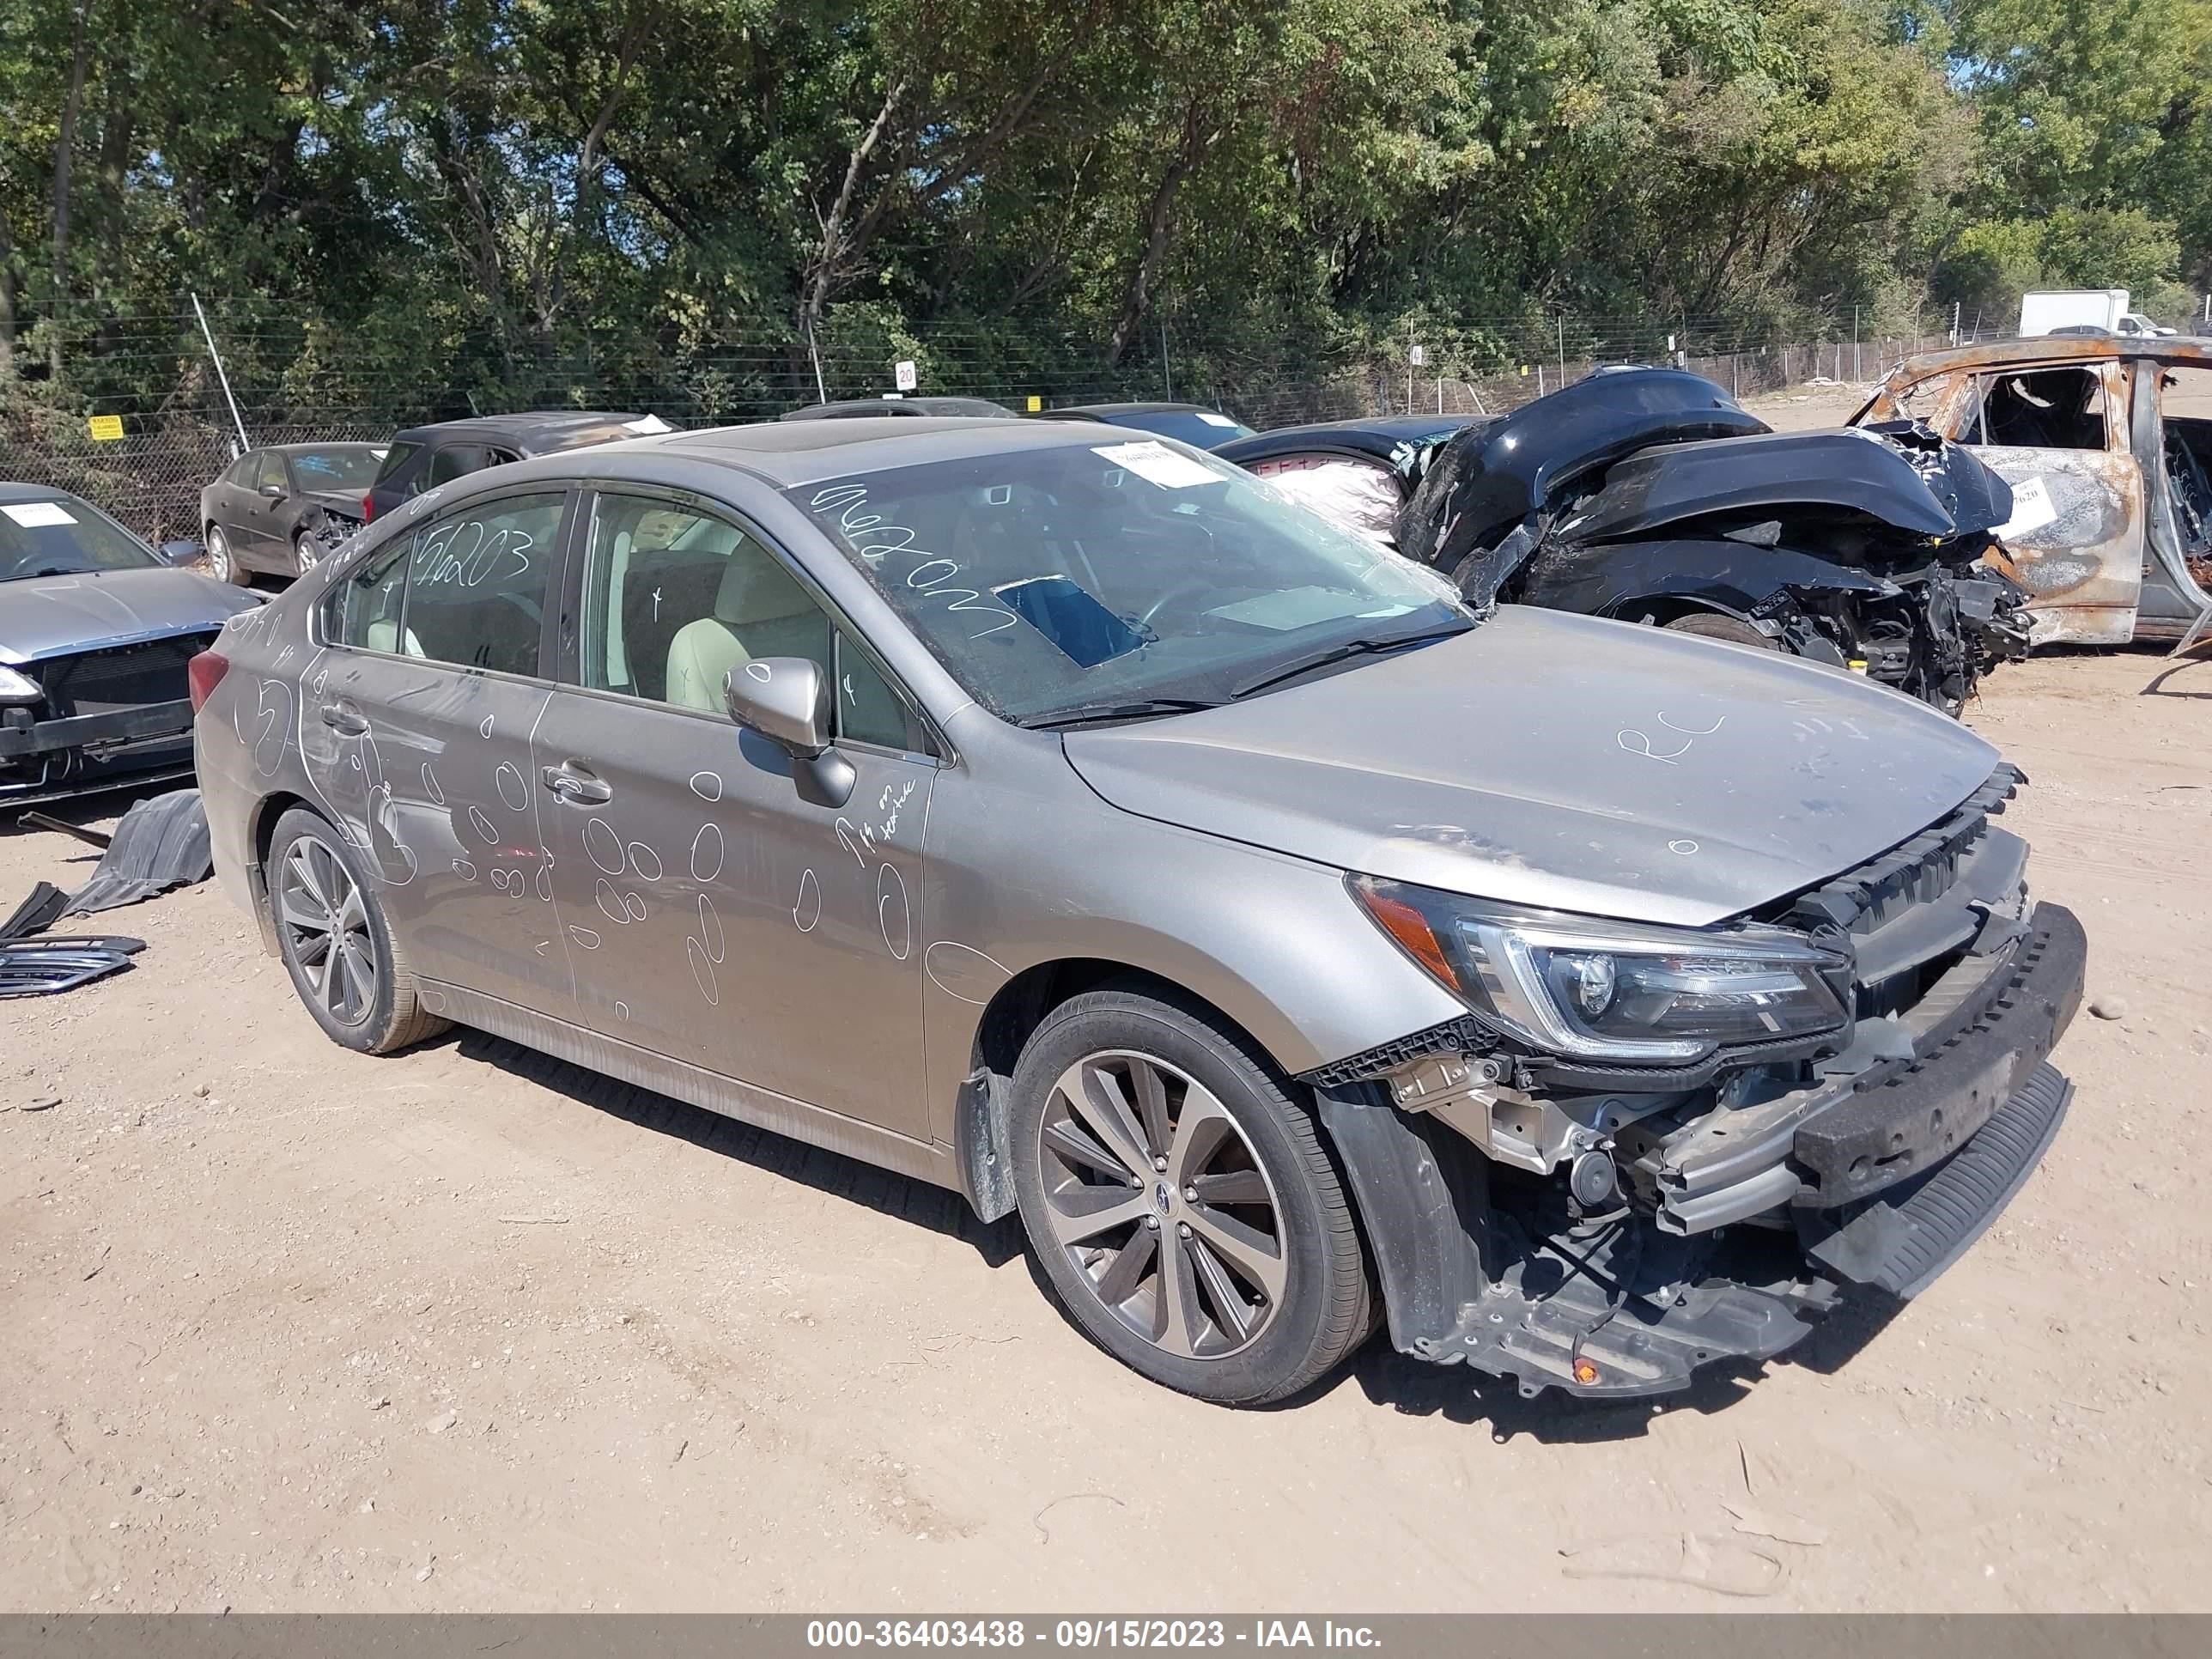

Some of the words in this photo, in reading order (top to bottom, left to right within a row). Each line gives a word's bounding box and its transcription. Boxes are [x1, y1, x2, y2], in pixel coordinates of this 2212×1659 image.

[899, 369, 912, 383] 20
[416, 521, 534, 587] 56203
[811, 483, 1018, 640] 56203
